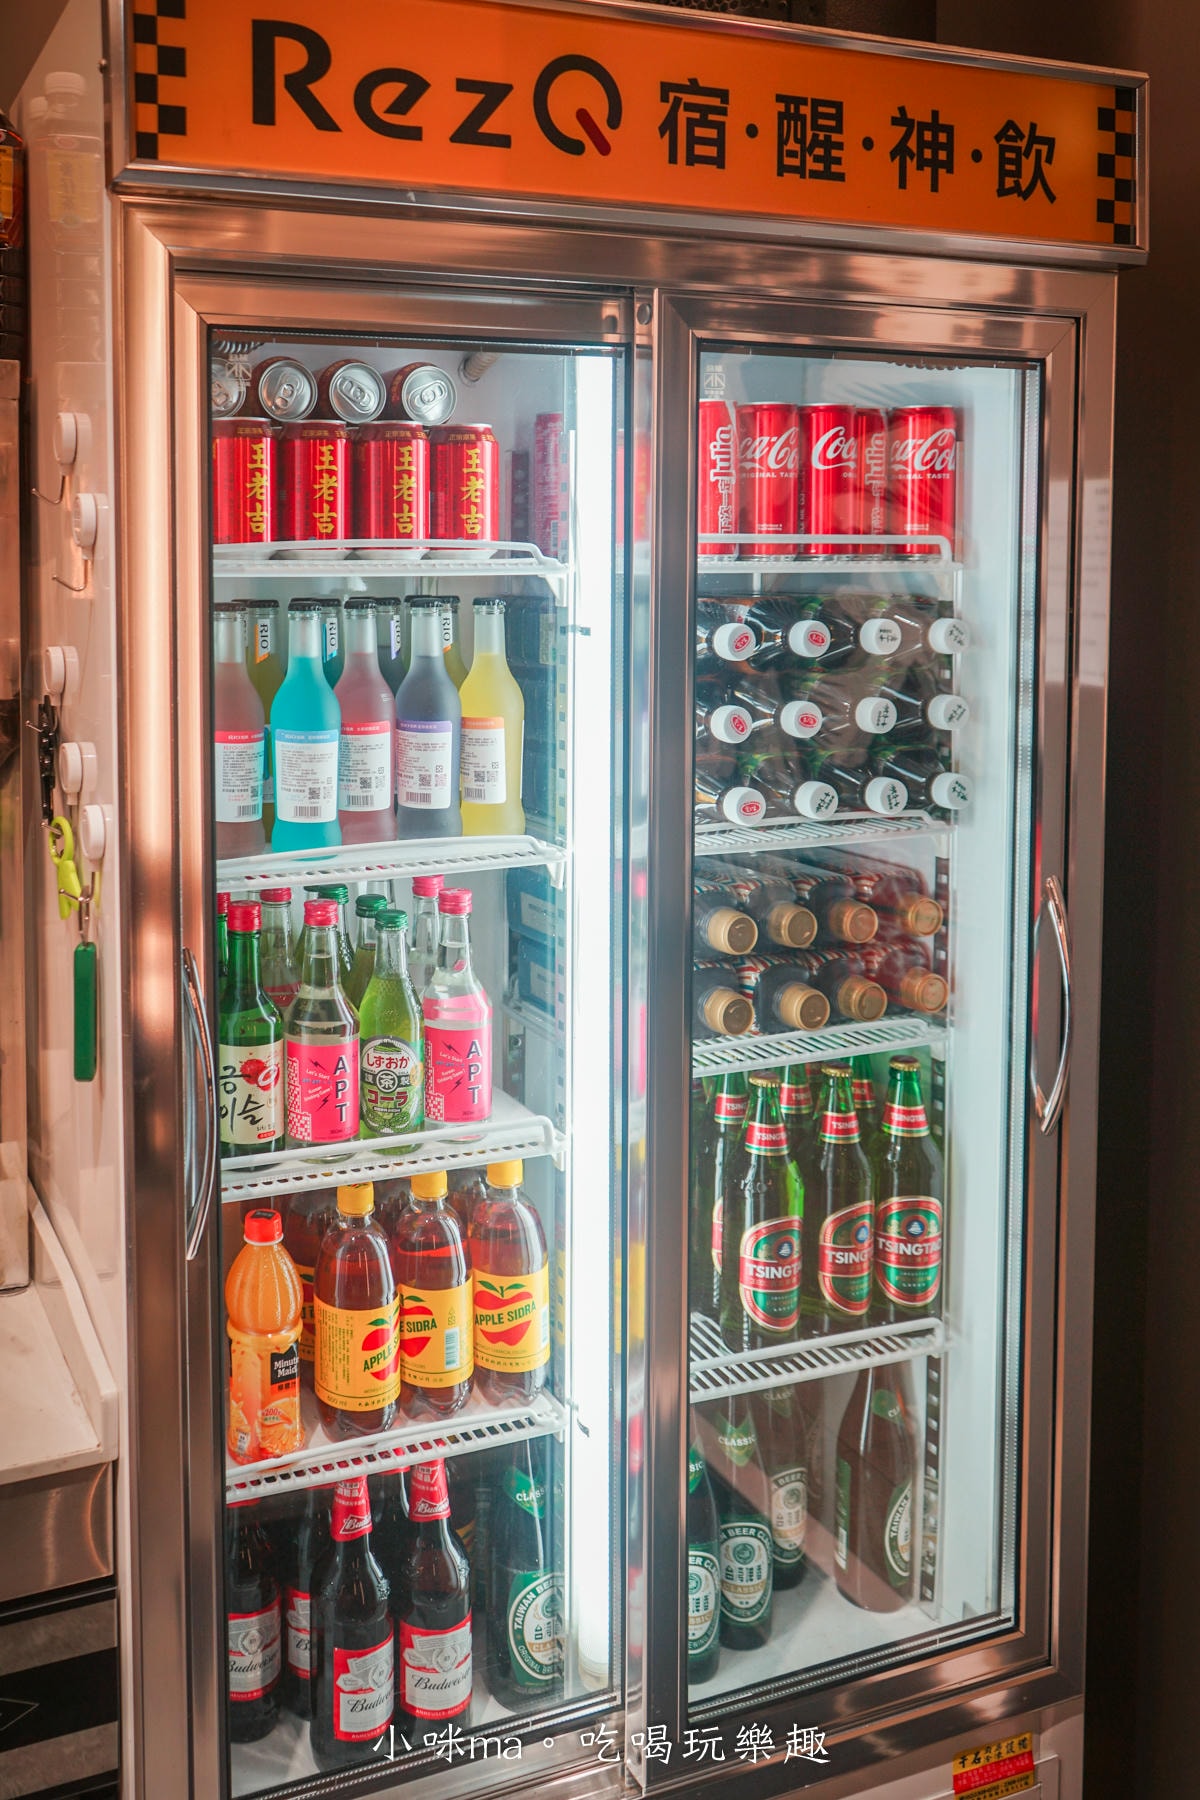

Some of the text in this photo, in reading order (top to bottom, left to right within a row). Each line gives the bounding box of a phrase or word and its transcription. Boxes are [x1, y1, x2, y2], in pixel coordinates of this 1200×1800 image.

[251, 18, 623, 157] RezQ
[246, 443, 269, 533] 王老吉
[313, 445, 338, 533] 王老吉
[394, 446, 416, 533] 王老吉
[461, 449, 485, 534] 王老吉
[259, 624, 269, 650] RIO
[329, 622, 338, 647] RIO
[442, 617, 450, 642] RIO
[467, 1039, 482, 1105] APT
[333, 1055, 350, 1123] APT
[368, 1089, 409, 1107] コーラ
[825, 1247, 873, 1264] TSING
[406, 1318, 437, 1333] SIDRA
[475, 1300, 537, 1326] APPLE SIDRA
[274, 1357, 299, 1370] Minut
[363, 1344, 392, 1372] APPLE
[729, 1527, 756, 1537] BEER
[514, 1591, 538, 1630] TAIWAN
